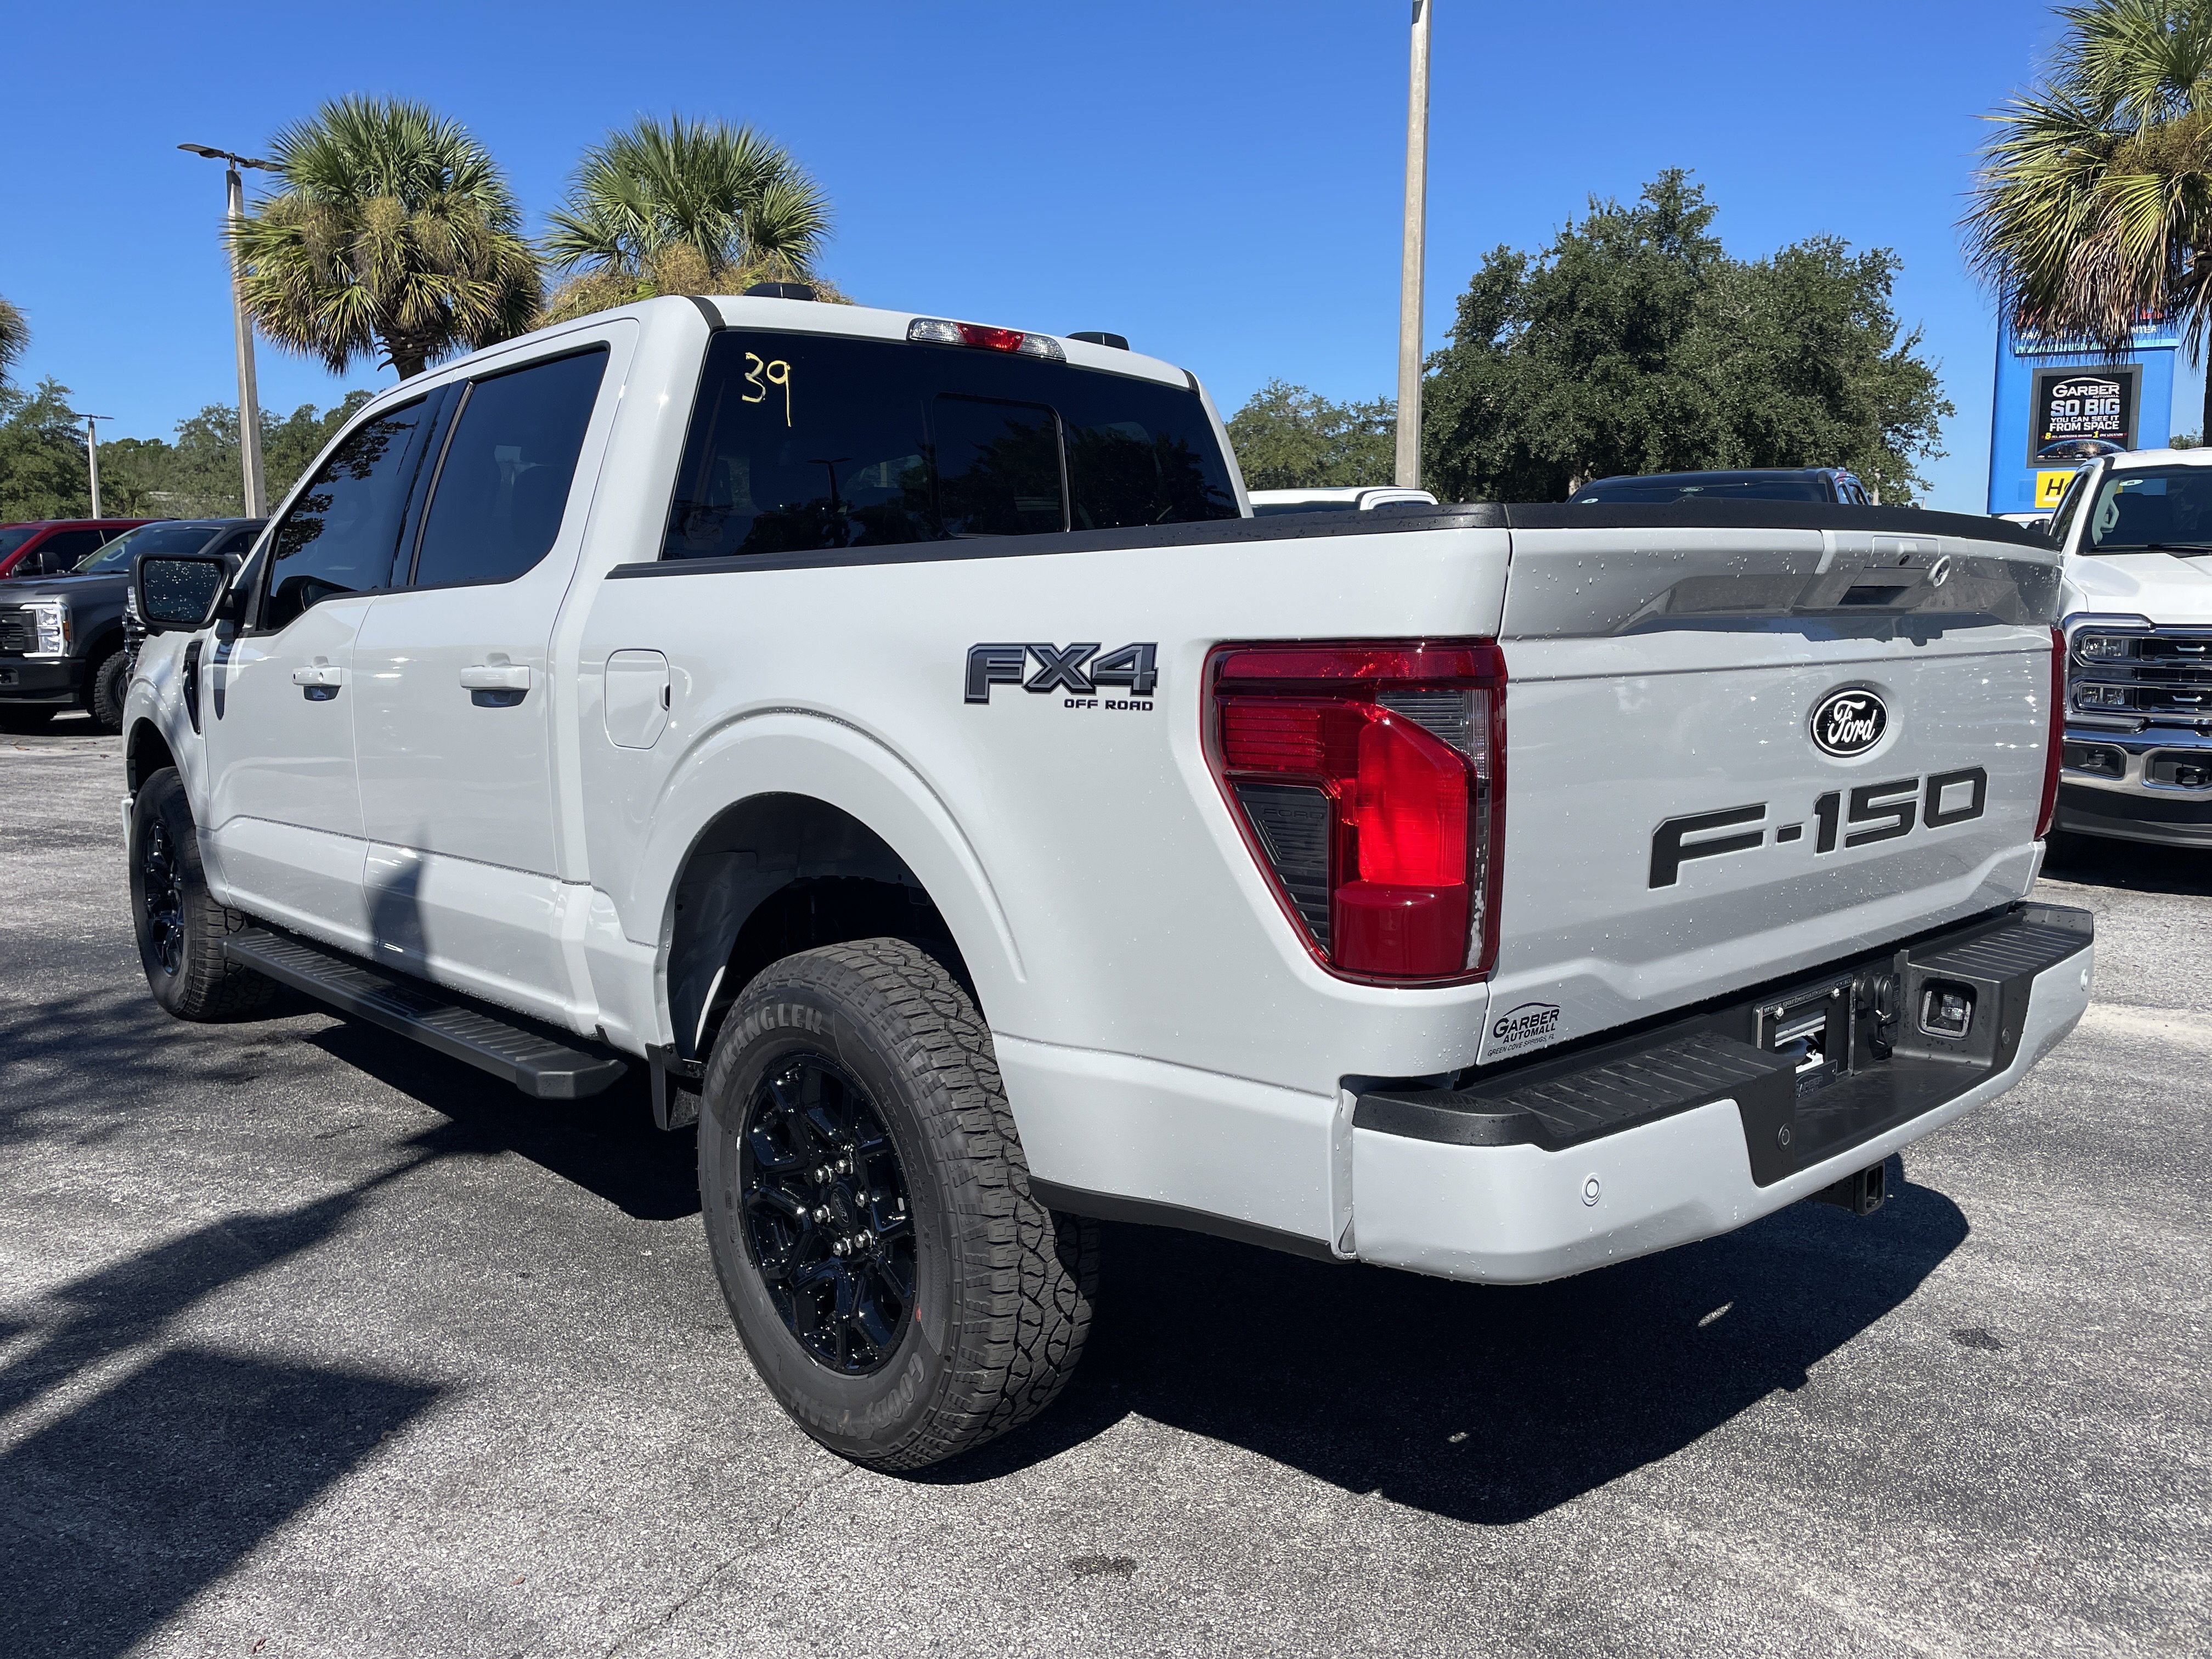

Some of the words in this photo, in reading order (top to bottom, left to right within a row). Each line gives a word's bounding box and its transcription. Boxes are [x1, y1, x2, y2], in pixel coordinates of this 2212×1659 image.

[742, 352, 791, 427] 39
[2052, 385, 2120, 398] GARBER
[2051, 399, 2080, 417] SO
[2084, 398, 2120, 416] BIG
[2050, 422, 2081, 432] FROM
[2084, 421, 2119, 431] SPACE
[2045, 478, 2070, 495] H
[964, 642, 1159, 706] FX4
[1064, 698, 1098, 709] OFF
[1105, 699, 1154, 712] ROAD
[1828, 700, 1877, 744] Ford
[1263, 809, 1324, 819] FORD
[1649, 766, 1988, 889] F-150
[1493, 1008, 1560, 1039] GARBER
[1503, 1023, 1556, 1044] AUTOMALL
[710, 1003, 822, 1097] WRANGLER
[1487, 1046, 1508, 1057] GREEN
[1508, 1042, 1525, 1051] COVE
